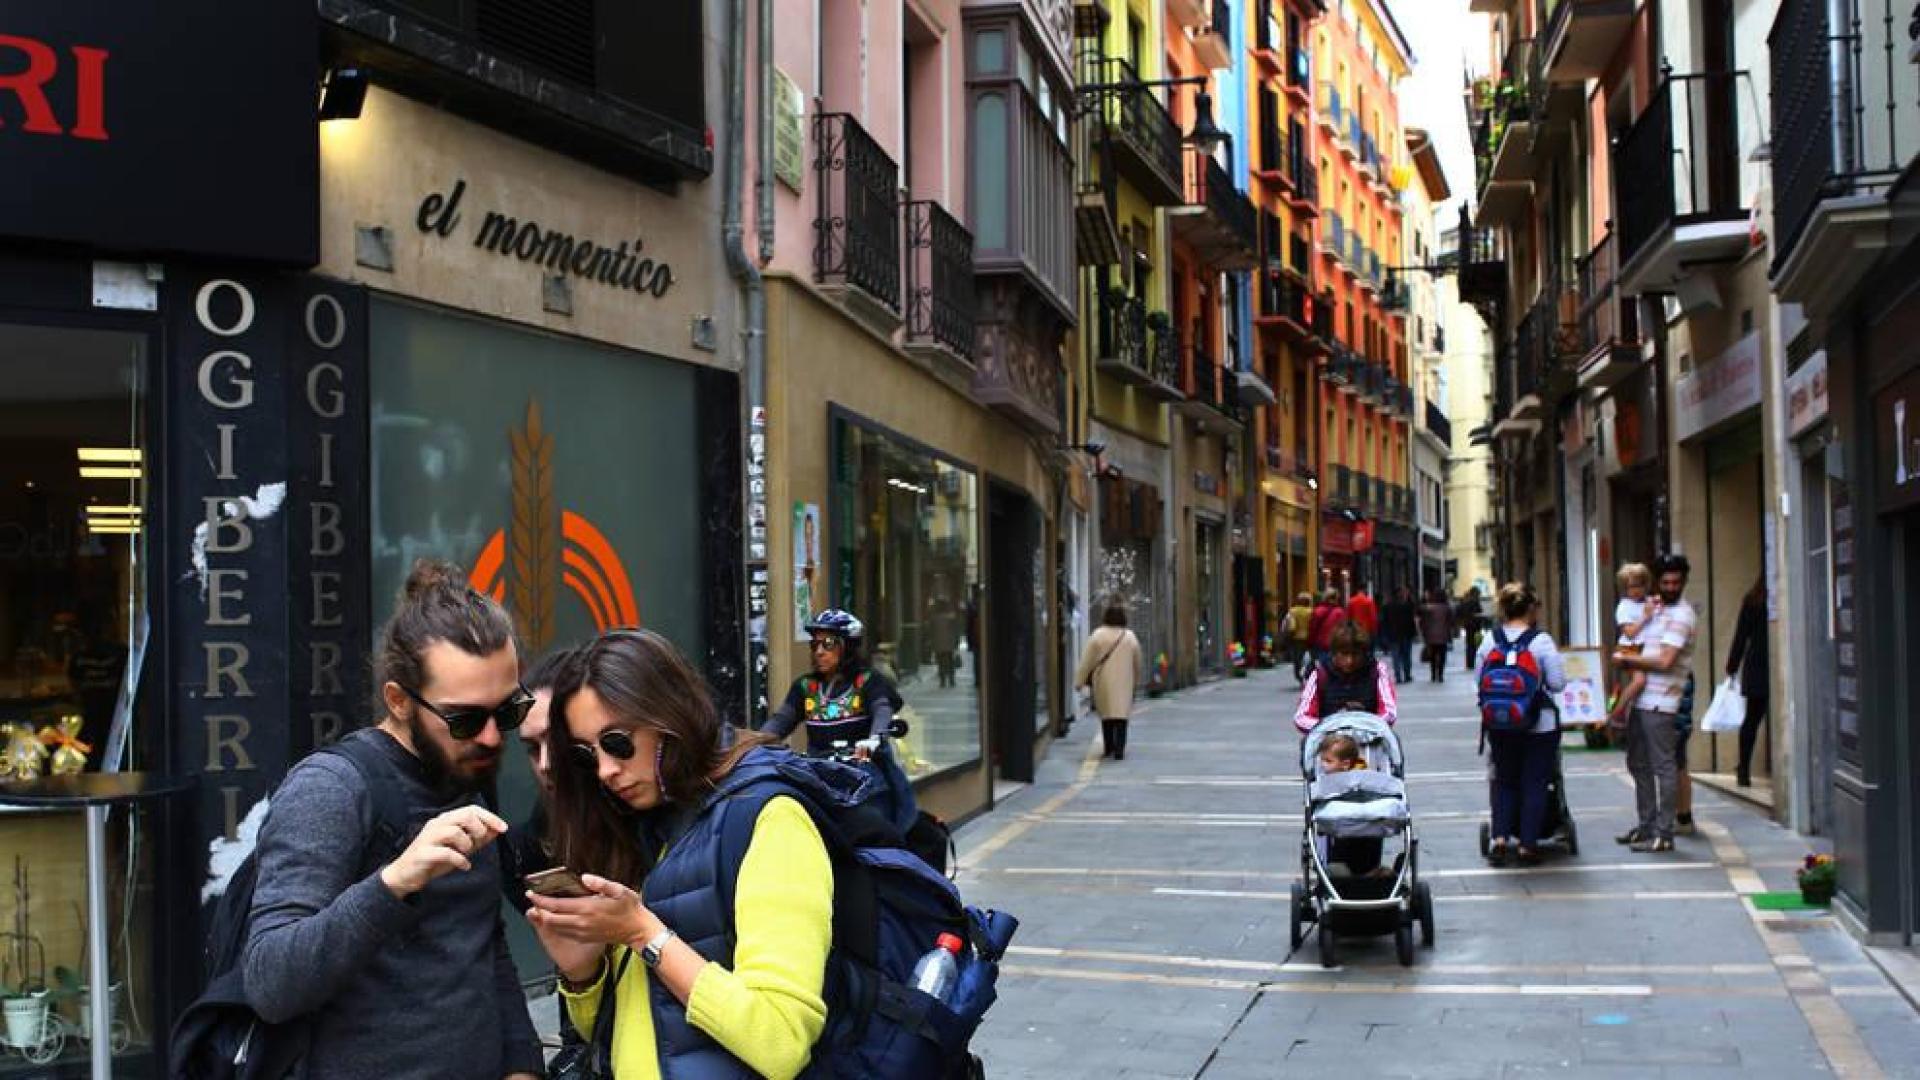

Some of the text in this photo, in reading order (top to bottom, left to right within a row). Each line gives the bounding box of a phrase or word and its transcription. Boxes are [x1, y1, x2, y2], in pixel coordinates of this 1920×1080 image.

[0, 33, 110, 140] RI
[416, 179, 675, 298] el momentico
[194, 278, 258, 842] OGIBERRI
